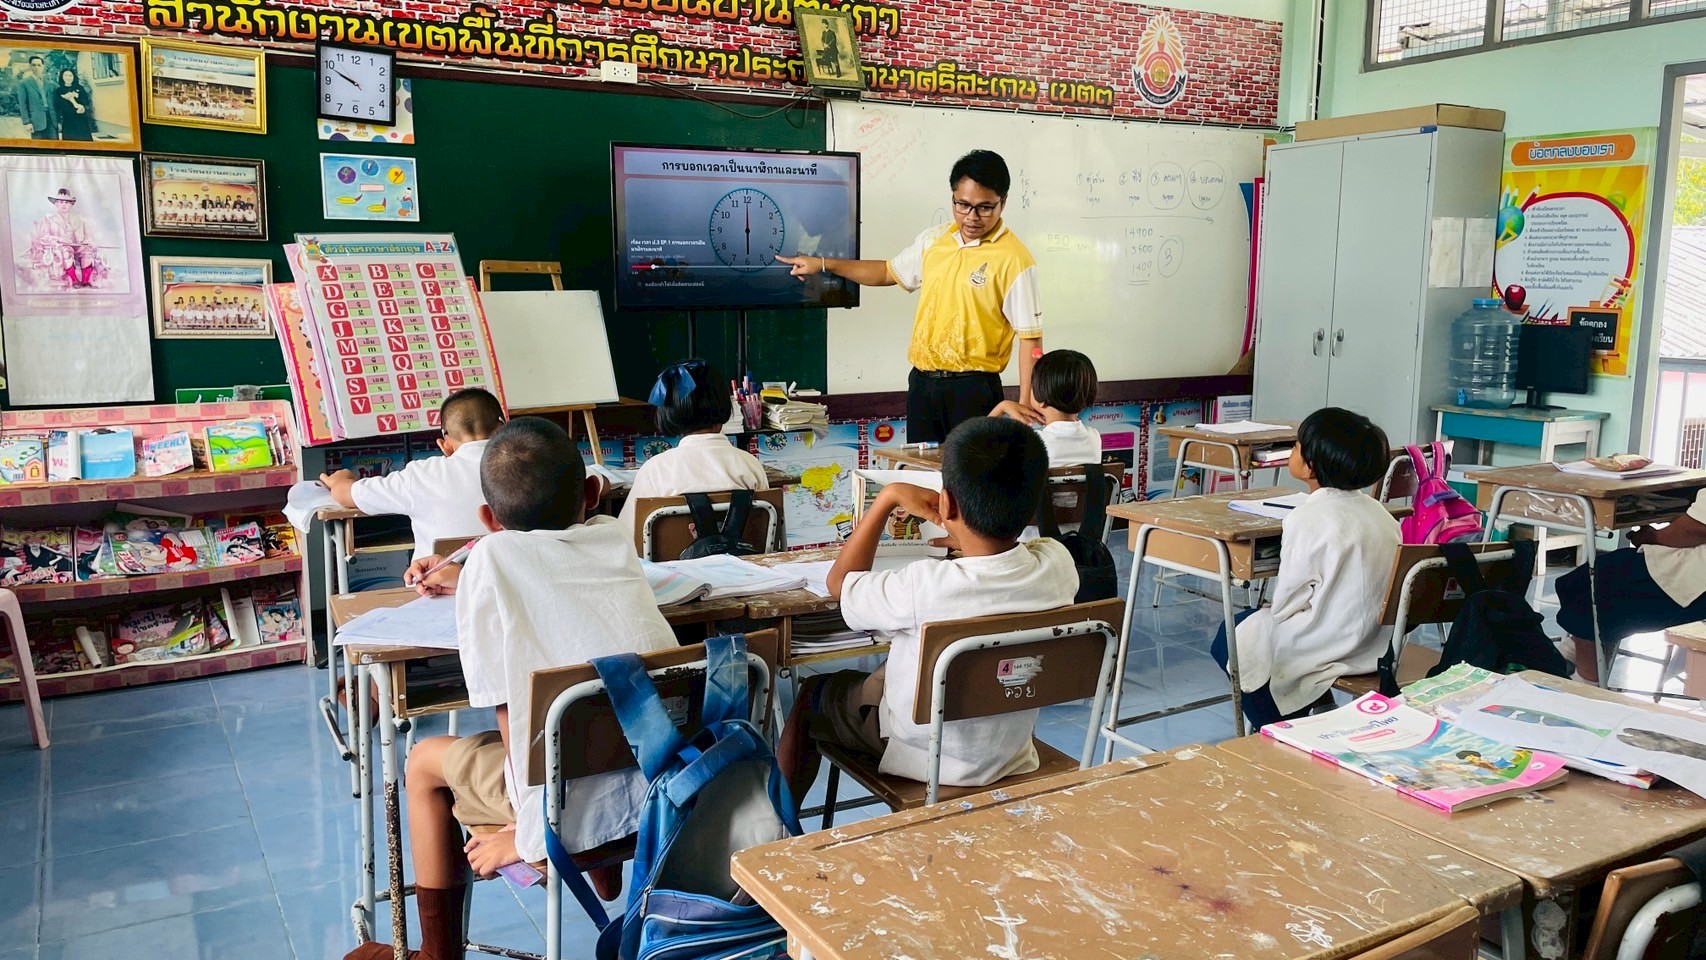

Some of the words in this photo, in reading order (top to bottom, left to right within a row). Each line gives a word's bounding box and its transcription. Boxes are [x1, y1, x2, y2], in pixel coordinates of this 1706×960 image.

[336, 53, 344, 63] 11
[350, 54, 361, 65] 12
[369, 57, 374, 67] 1
[324, 60, 335, 70] 10
[379, 67, 385, 76] 2
[325, 76, 331, 85] 9
[379, 84, 385, 92] 3
[325, 94, 331, 102] 8
[378, 100, 385, 108] 4
[337, 103, 343, 111] 7
[352, 105, 358, 114] 6
[368, 107, 375, 115] 5
[1529, 142, 1614, 159] ข้อตกลงของเรา
[662, 159, 817, 176] การบอกเวลาเป็นนาฬิกาและนาที
[731, 200, 739, 208] 11
[743, 196, 752, 204] 12
[721, 211, 730, 219] 10
[425, 241, 450, 252] A-Z
[321, 266, 336, 279] A
[370, 265, 384, 278] B
[420, 265, 433, 277] C
[322, 285, 339, 299] D
[375, 283, 390, 296] E
[424, 282, 435, 295] F
[329, 304, 345, 316] G
[380, 301, 396, 314] H
[429, 299, 438, 312] I
[336, 322, 345, 336] J
[386, 320, 402, 333] K
[434, 318, 447, 330] L
[339, 340, 356, 354] M
[389, 337, 404, 350] N
[440, 334, 453, 347] O
[395, 355, 410, 371] Q
[443, 353, 457, 365] R
[344, 360, 356, 373] P
[399, 375, 411, 388] T
[447, 371, 461, 384] U
[349, 379, 360, 393] S
[352, 399, 366, 412] V
[403, 394, 418, 407] W
[380, 416, 394, 430] Y
[430, 412, 441, 425] Z
[1002, 663, 1010, 674] 4
